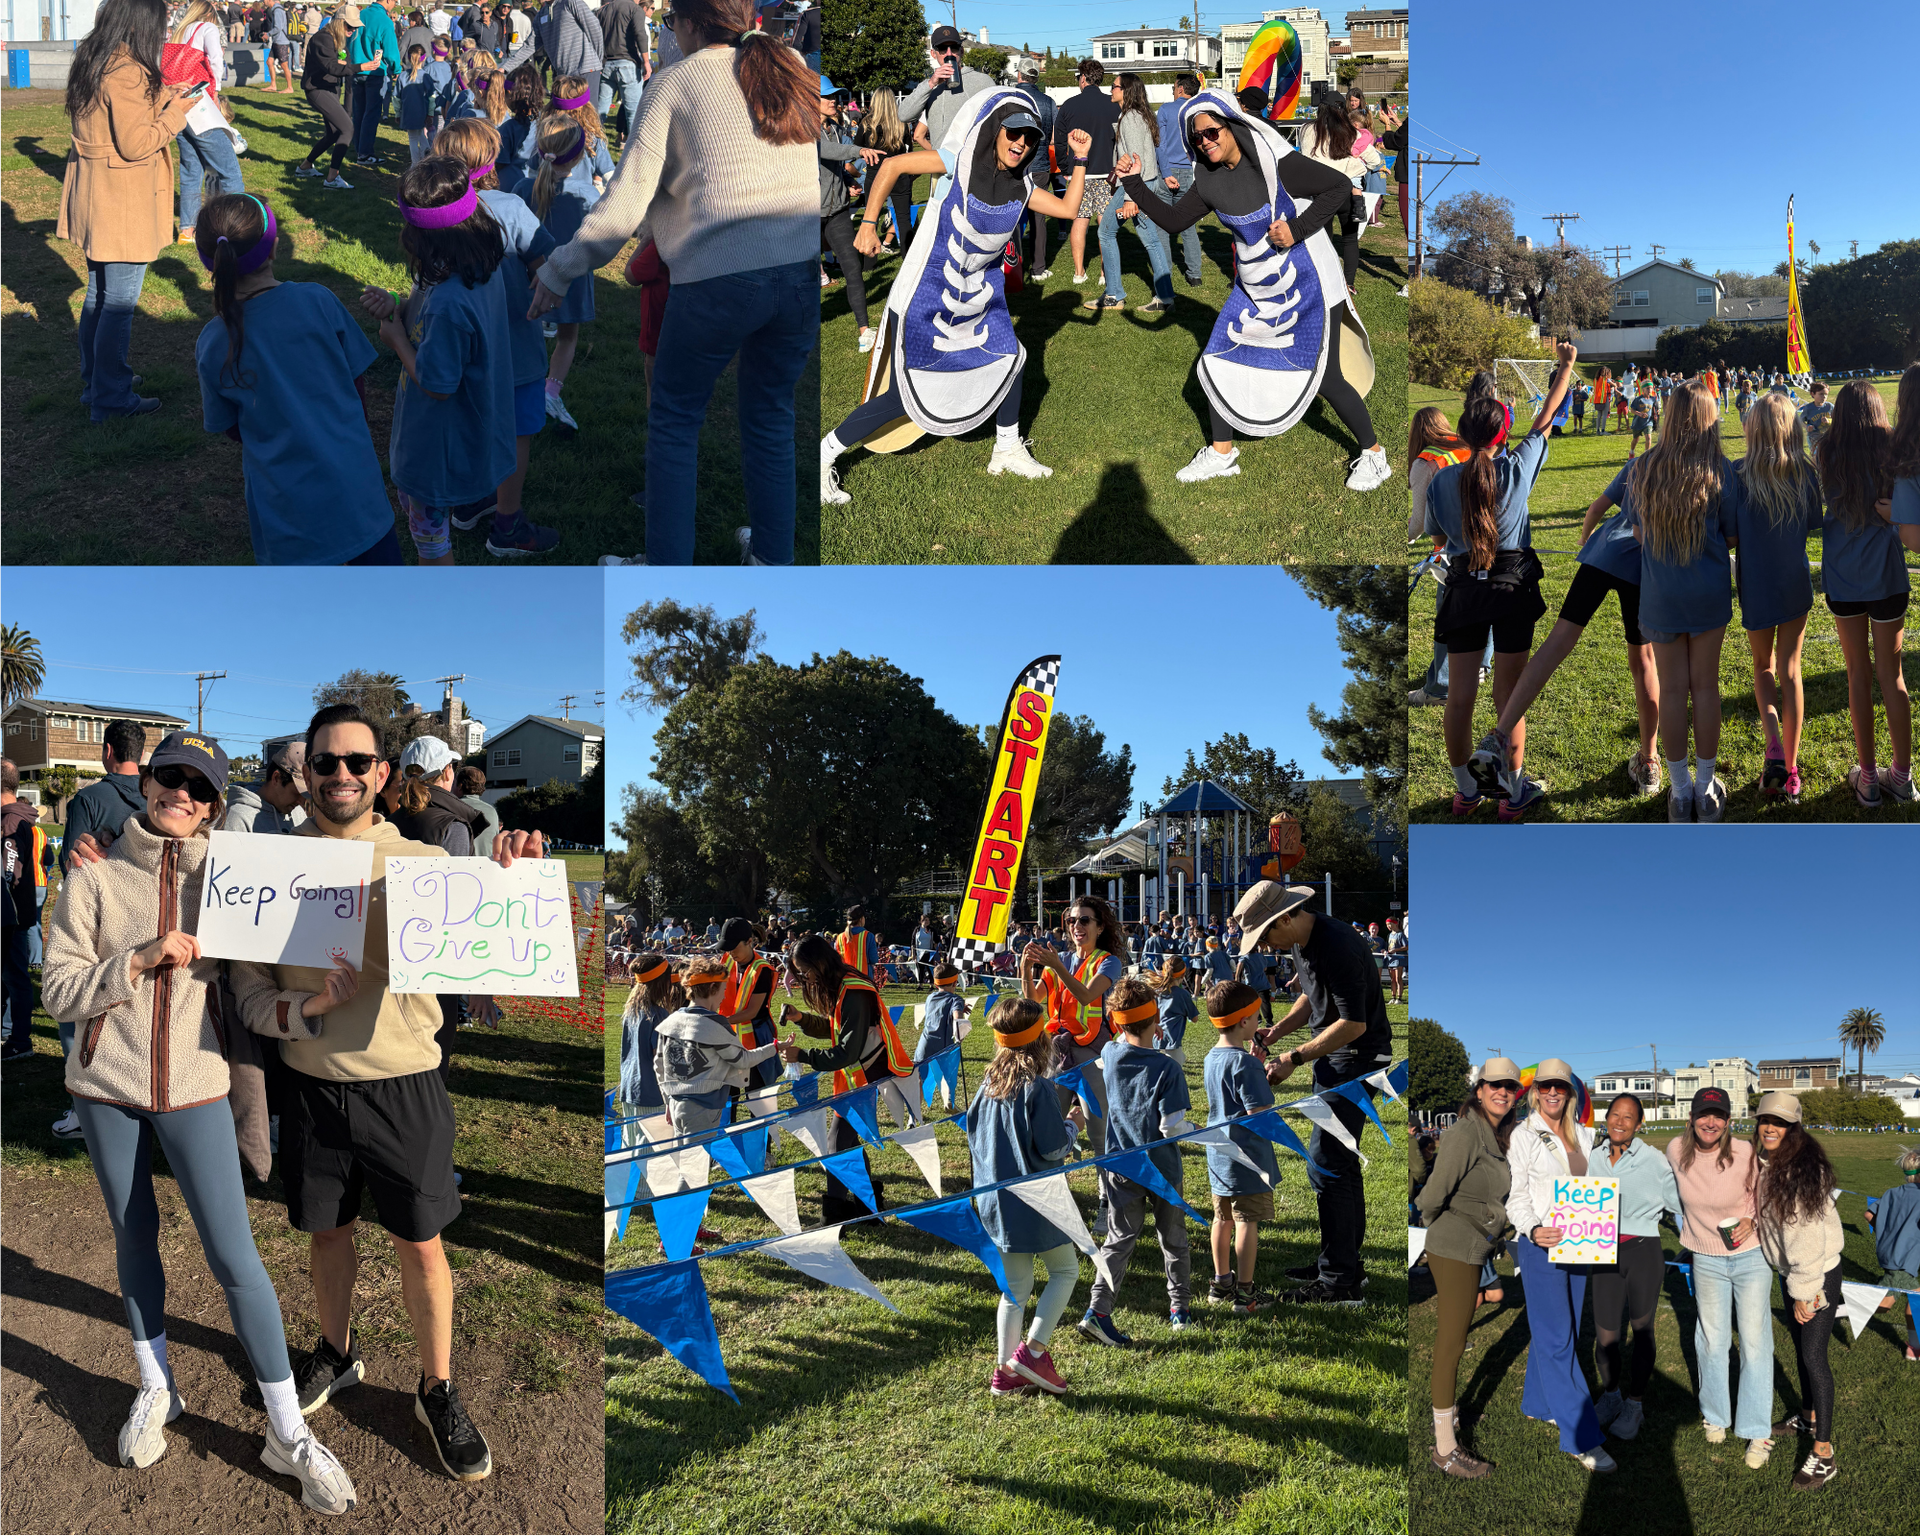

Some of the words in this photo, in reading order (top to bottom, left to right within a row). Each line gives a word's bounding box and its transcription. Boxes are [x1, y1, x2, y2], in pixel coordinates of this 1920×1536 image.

[182, 737, 215, 760] UCLA
[967, 690, 1047, 937] START
[206, 857, 277, 926] Keep
[289, 873, 364, 923] Going!
[412, 870, 564, 930] Dont
[399, 917, 491, 963] Give
[1554, 1179, 1615, 1211] Keep
[1552, 1212, 1616, 1250] Going
